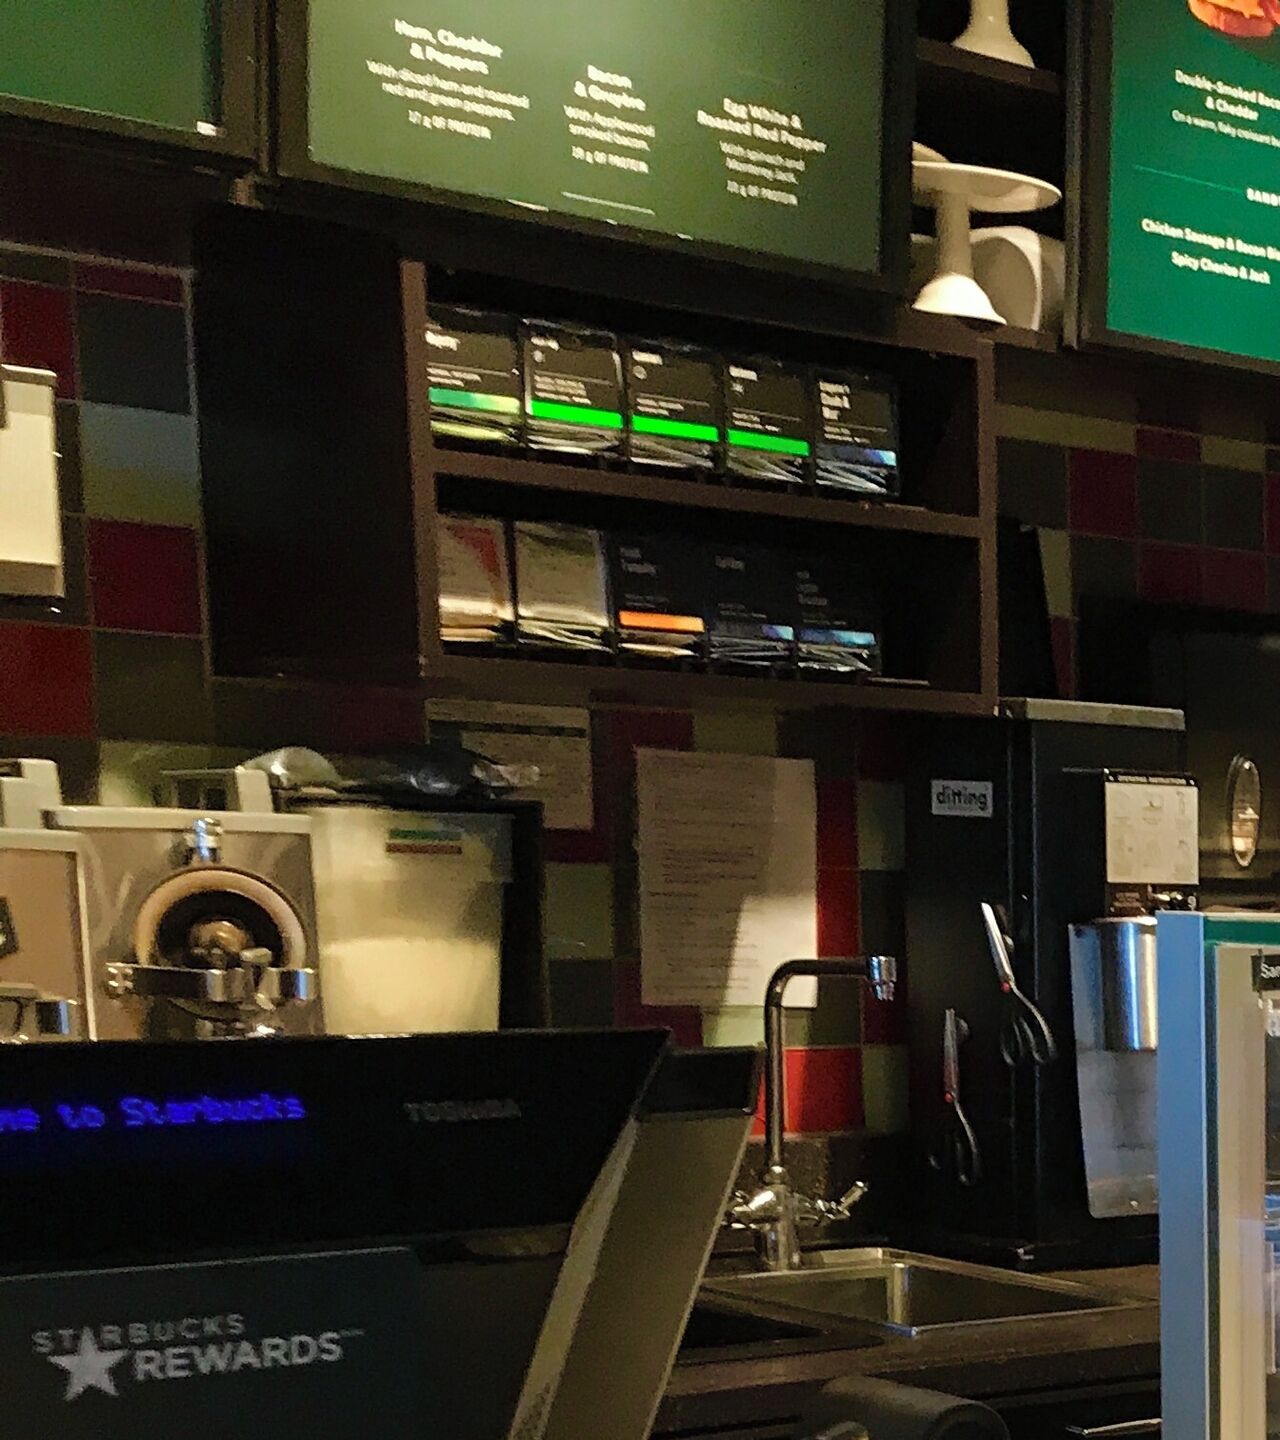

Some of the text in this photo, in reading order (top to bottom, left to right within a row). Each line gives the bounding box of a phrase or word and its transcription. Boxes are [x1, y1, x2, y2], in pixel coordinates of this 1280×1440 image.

[410, 42, 489, 74] & Peppers
[437, 28, 502, 58] Cheddar
[574, 81, 588, 98] &
[749, 103, 790, 127] White
[1205, 96, 1259, 121] & Cheddar
[753, 122, 780, 143] Red
[780, 129, 827, 153] Pepper
[1141, 218, 1184, 239] Chicken
[1184, 228, 1225, 250] Sausage
[1225, 237, 1235, 251] &
[1235, 239, 1266, 258] Bacon
[1171, 250, 1270, 285] Spicy Chorizo & Jack
[935, 784, 988, 813] ditting
[53, 1103, 106, 1131] to
[115, 1091, 308, 1129] Starbucks
[31, 1312, 245, 1355] STARBUCKS
[131, 1331, 344, 1385] REWARDS
